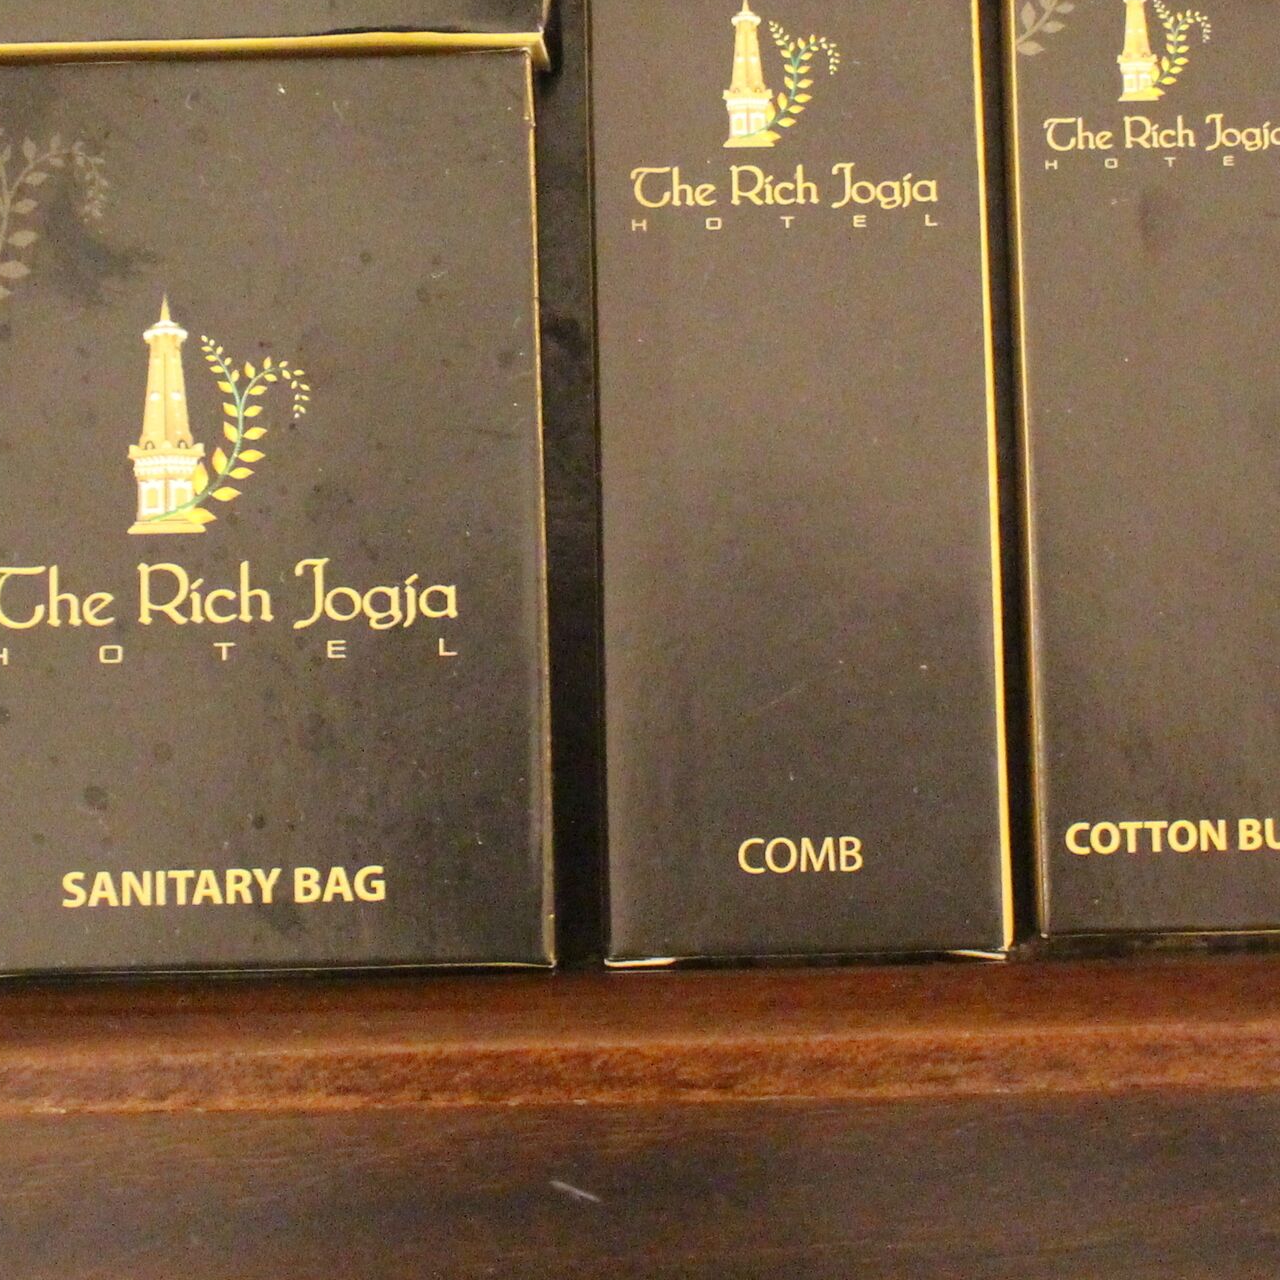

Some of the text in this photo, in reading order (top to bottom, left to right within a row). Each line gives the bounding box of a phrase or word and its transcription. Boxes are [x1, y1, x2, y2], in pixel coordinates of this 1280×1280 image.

[1042, 116, 1114, 152] The
[1122, 113, 1197, 150] Rich
[630, 162, 940, 210] The Rich Jogja
[135, 559, 275, 627] Rich
[293, 556, 460, 631] Jogja
[737, 835, 864, 875] COMB
[1065, 819, 1228, 855] COTTON
[61, 865, 387, 909] SANITARY BAG
